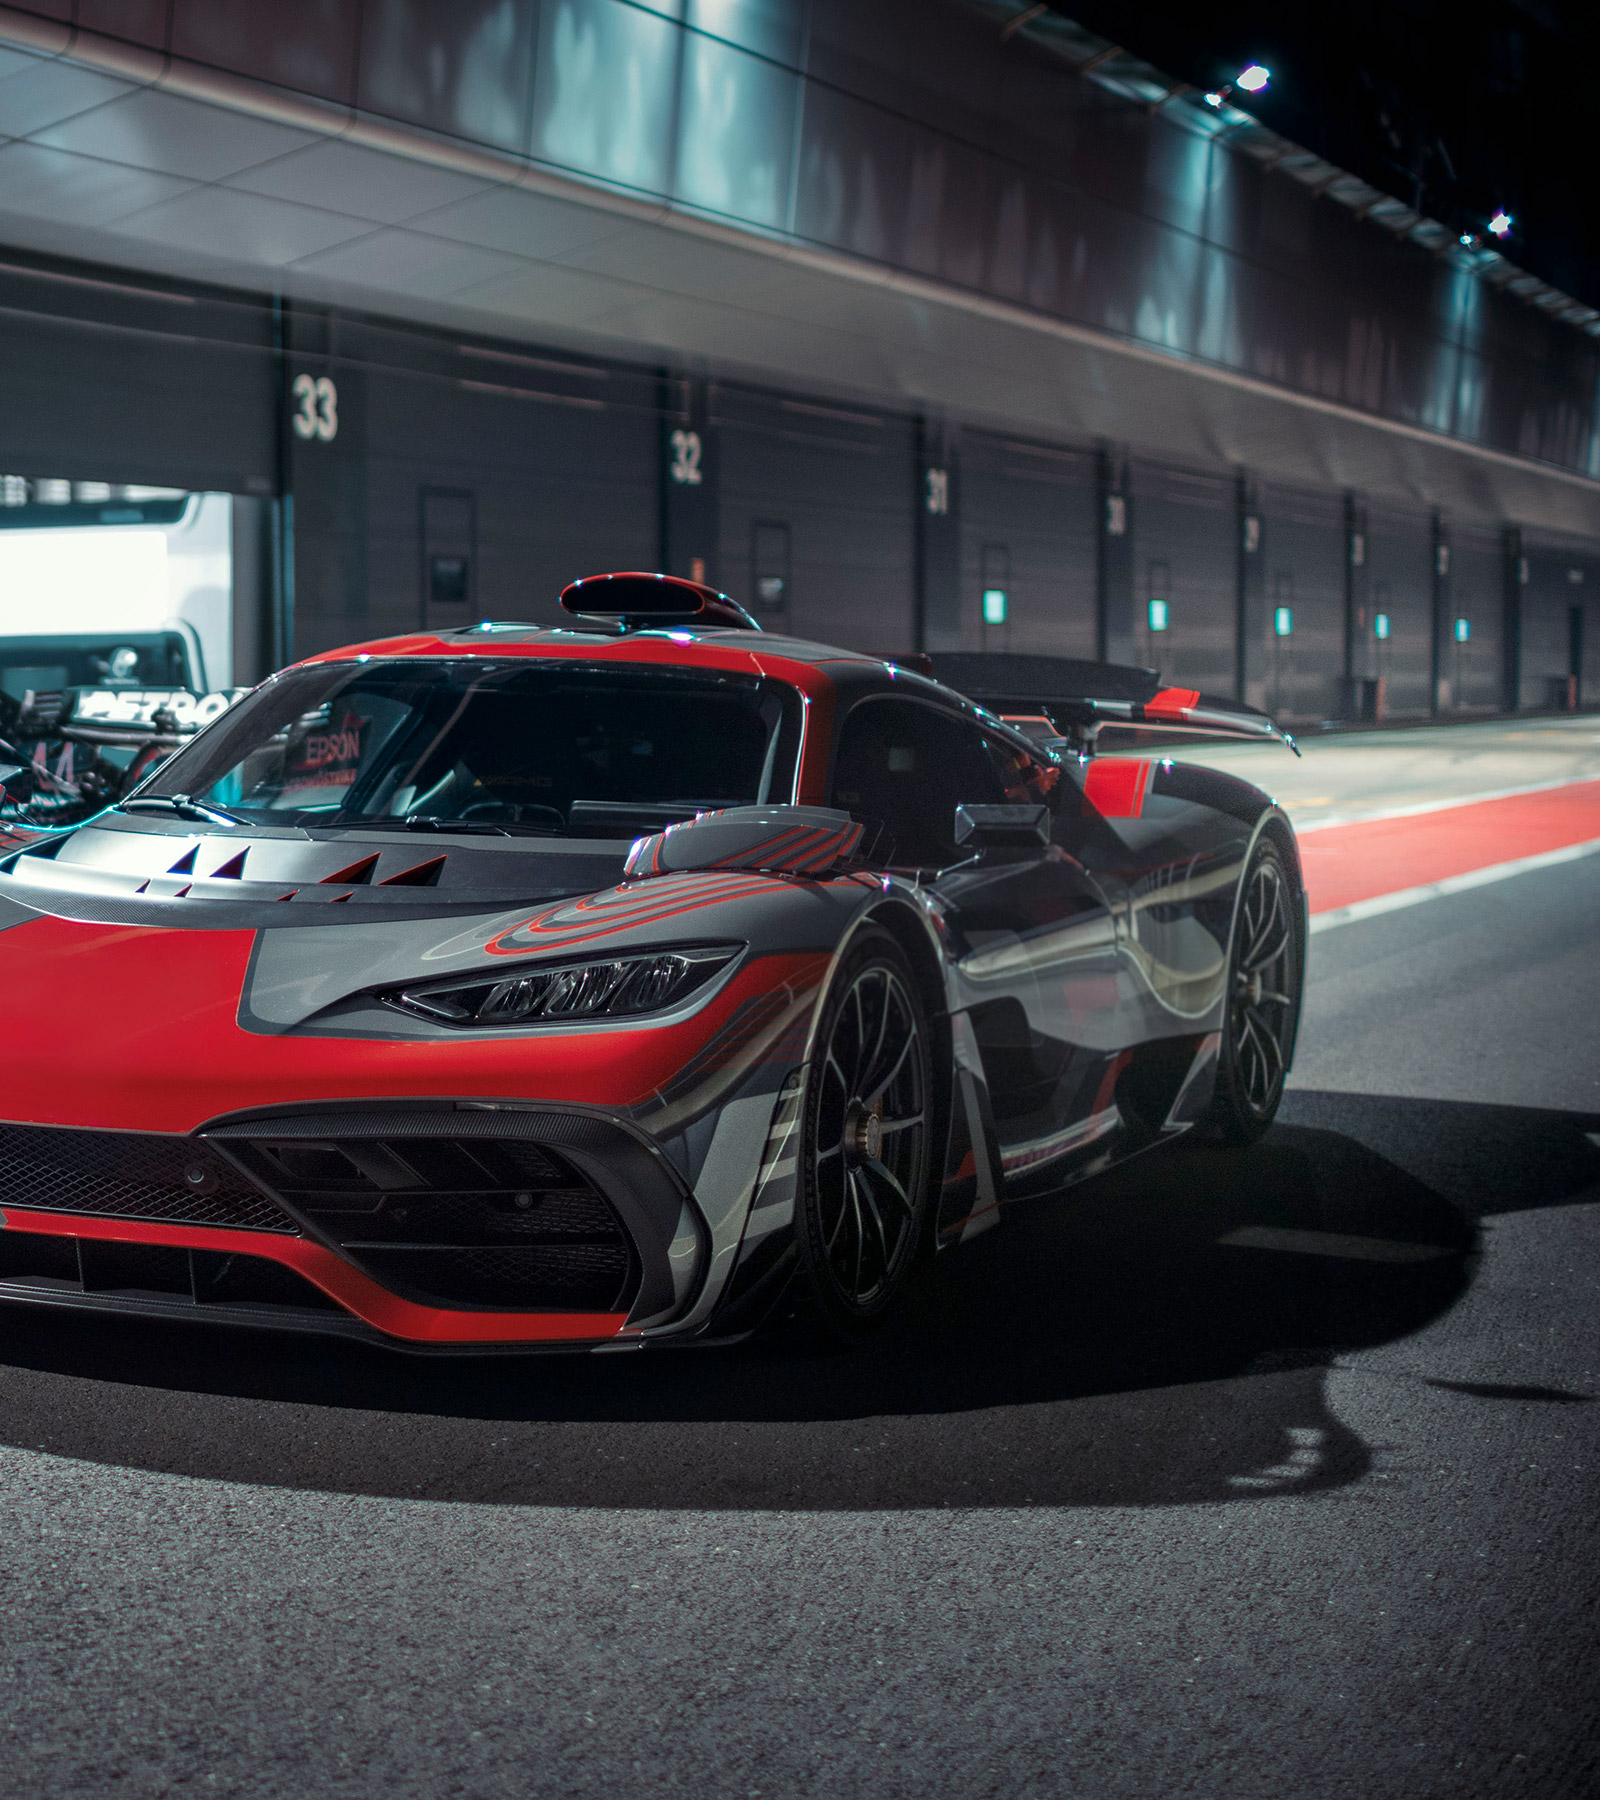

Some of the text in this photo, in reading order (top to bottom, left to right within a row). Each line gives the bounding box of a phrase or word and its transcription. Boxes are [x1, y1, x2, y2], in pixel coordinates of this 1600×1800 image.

[292, 373, 338, 442] 33
[671, 429, 702, 485] 32
[306, 729, 359, 762] EPSON
